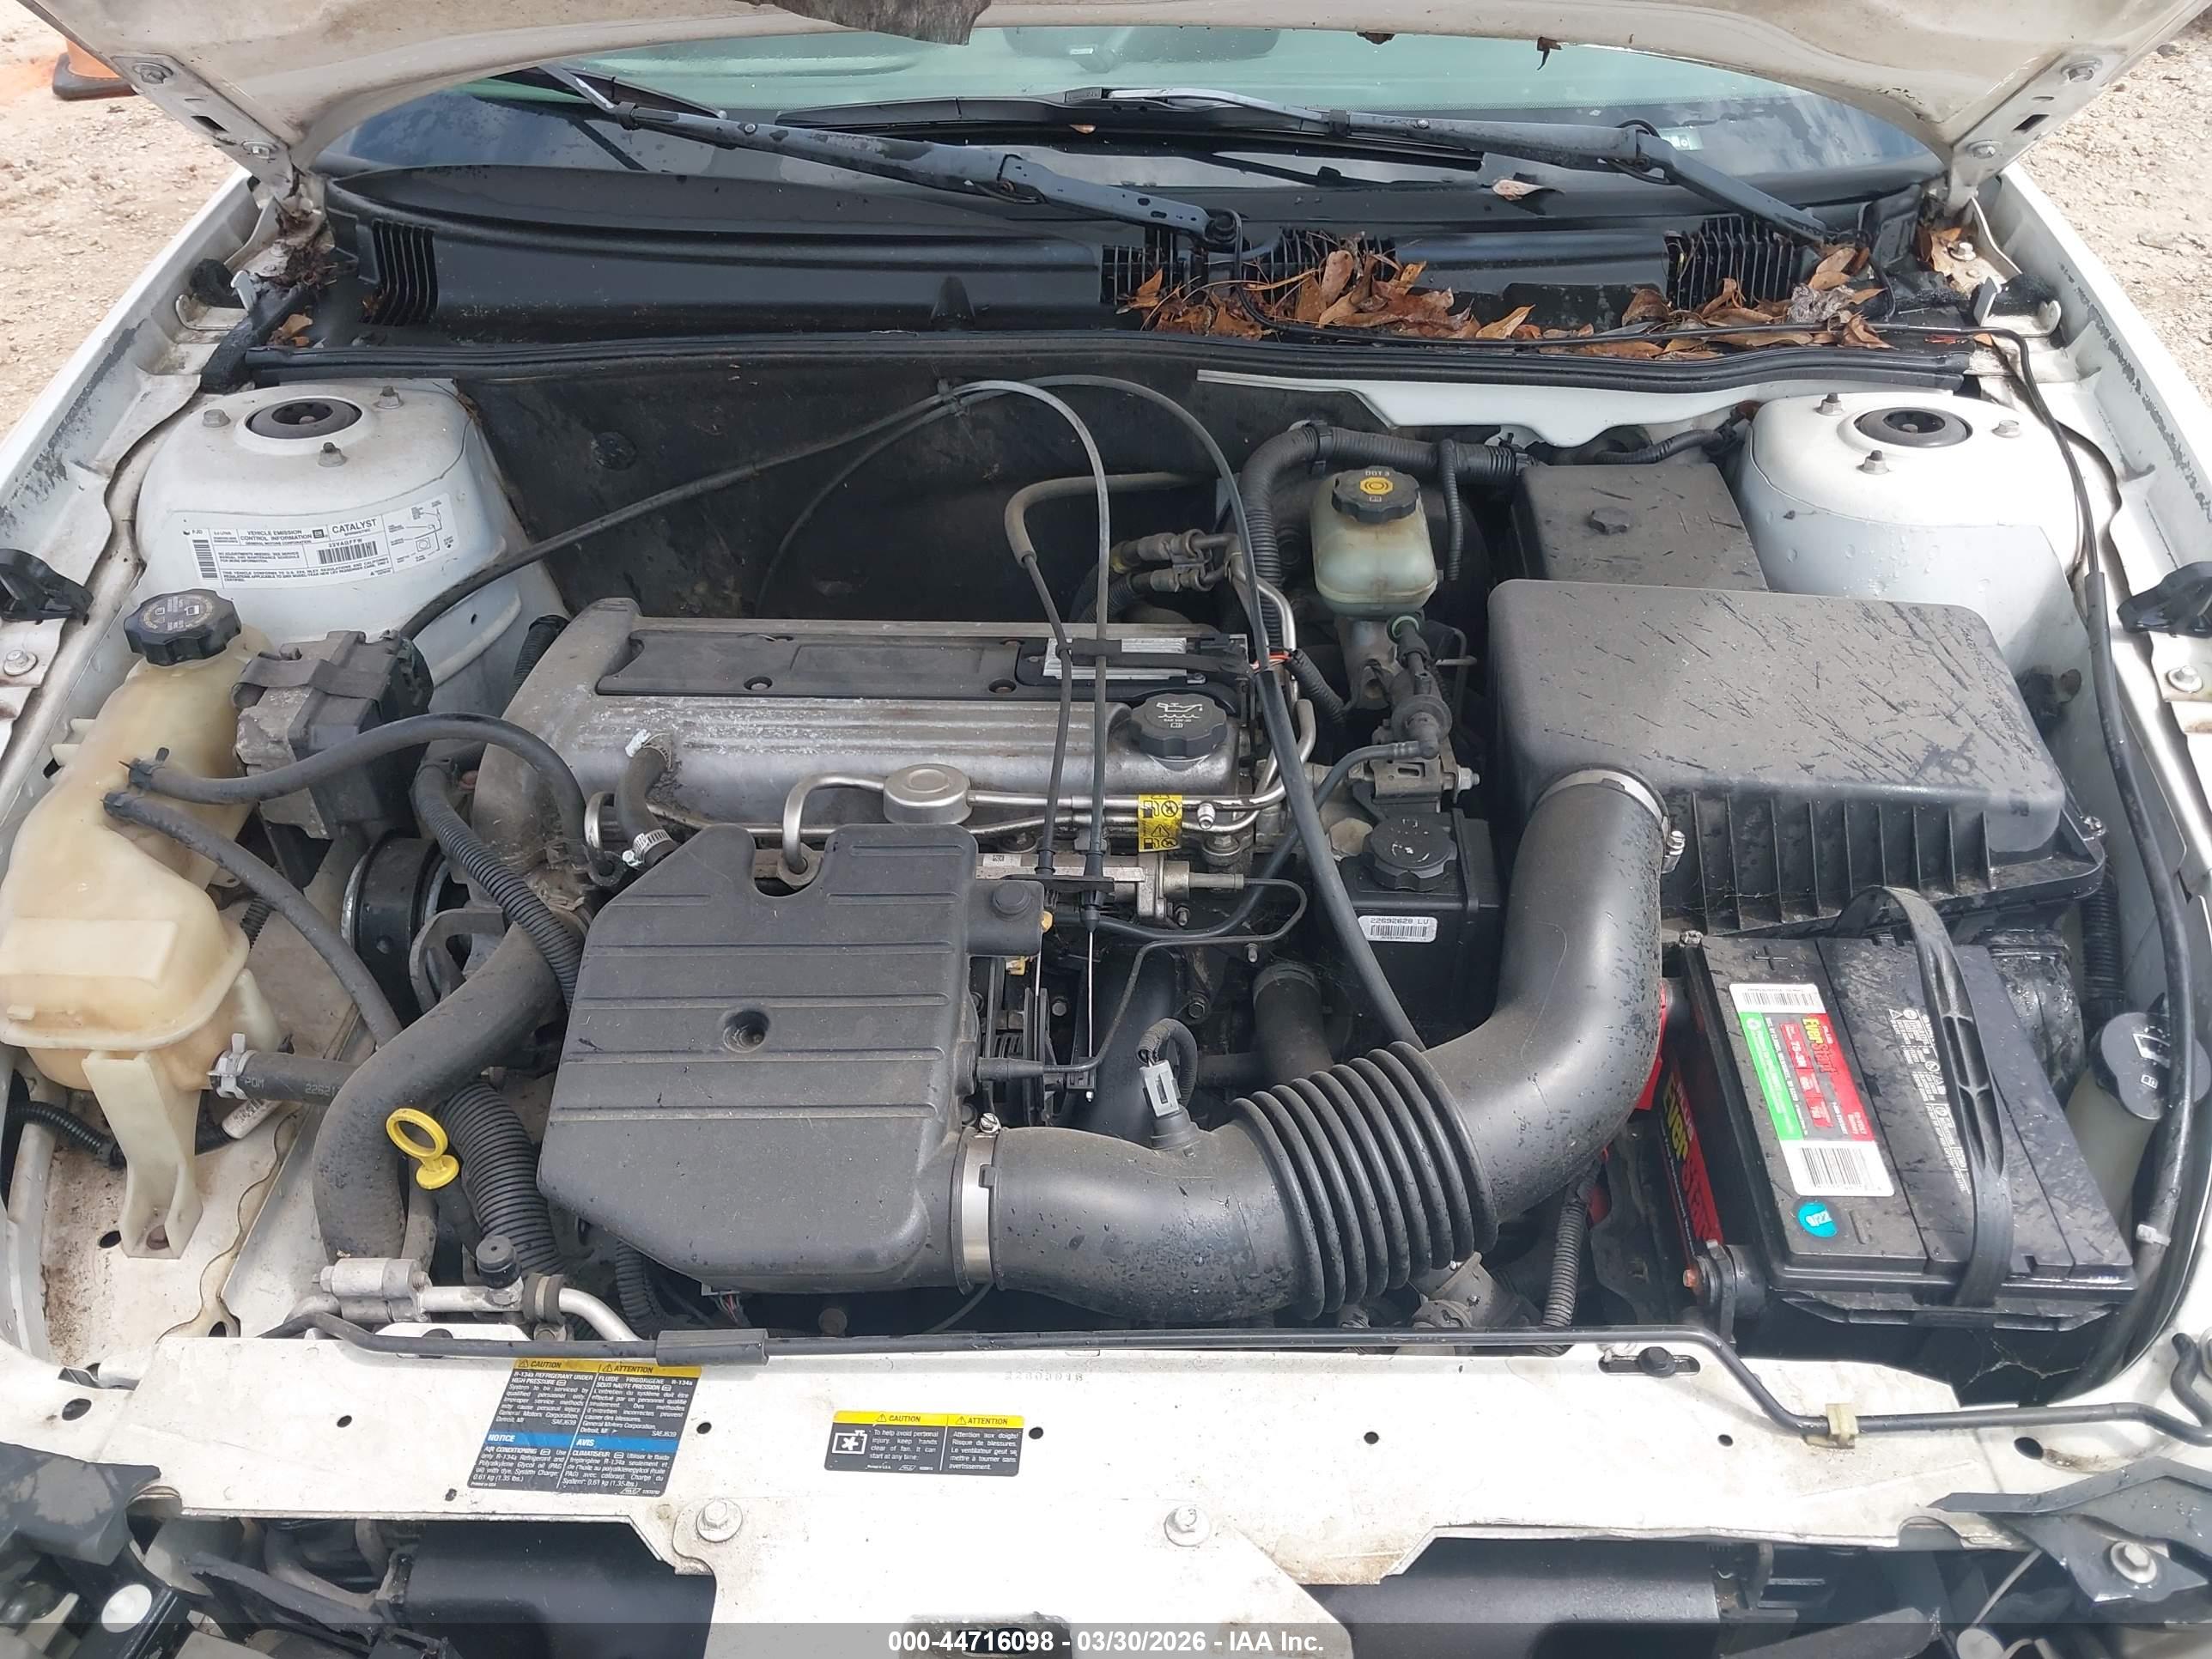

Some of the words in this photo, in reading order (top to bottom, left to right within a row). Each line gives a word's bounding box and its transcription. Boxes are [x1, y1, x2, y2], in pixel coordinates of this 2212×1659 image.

[331, 519, 377, 534] CATALYST
[530, 1360, 562, 1369] CAUTION
[614, 1365, 653, 1374] ATTENTION
[487, 1434, 516, 1443] NOTICE
[575, 1438, 595, 1447] AVIS
